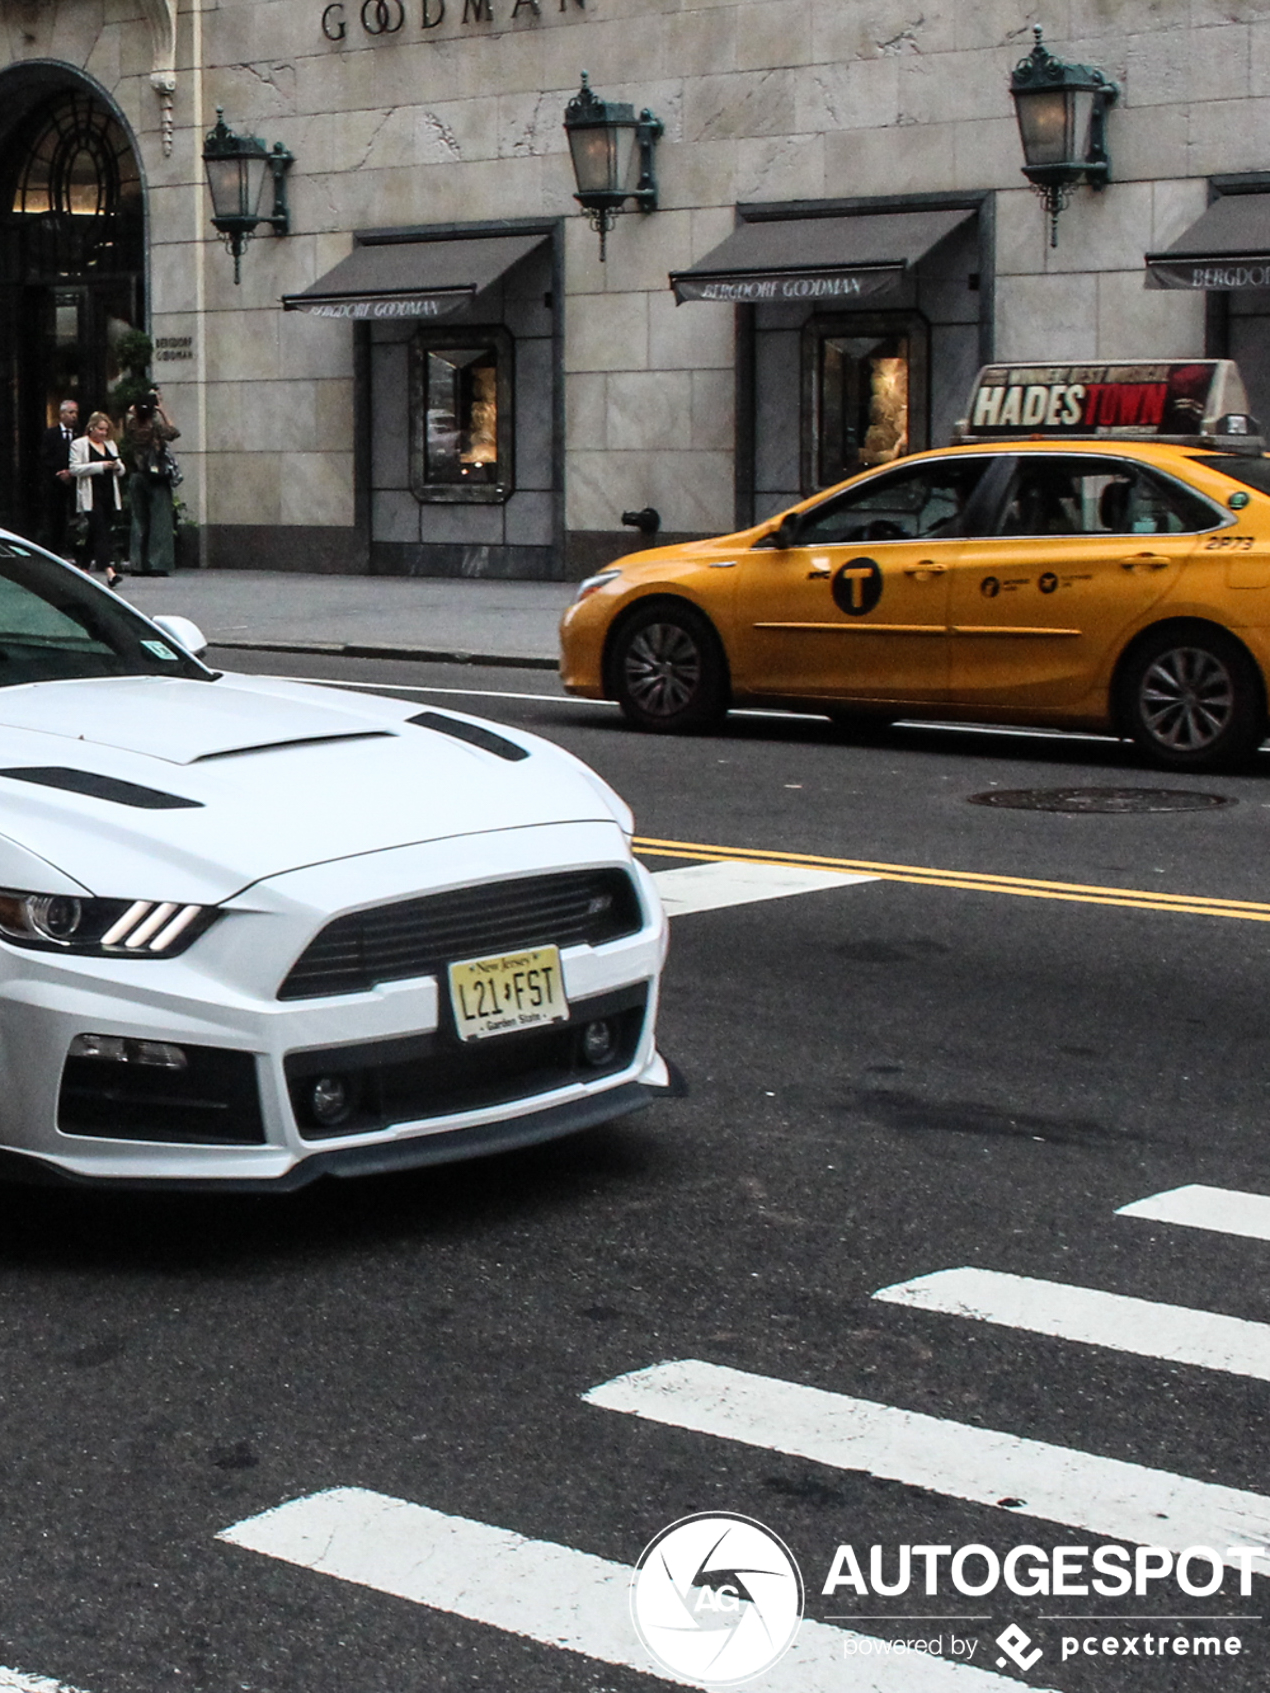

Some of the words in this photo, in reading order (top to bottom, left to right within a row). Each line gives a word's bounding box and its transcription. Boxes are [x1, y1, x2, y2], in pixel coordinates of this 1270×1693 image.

[701, 281, 778, 300] BERGDORF
[783, 278, 861, 297] GOODMAN
[374, 301, 440, 317] GOODMAN
[843, 568, 874, 608] T
[486, 1017, 517, 1031] Garden
[518, 1012, 541, 1025] State
